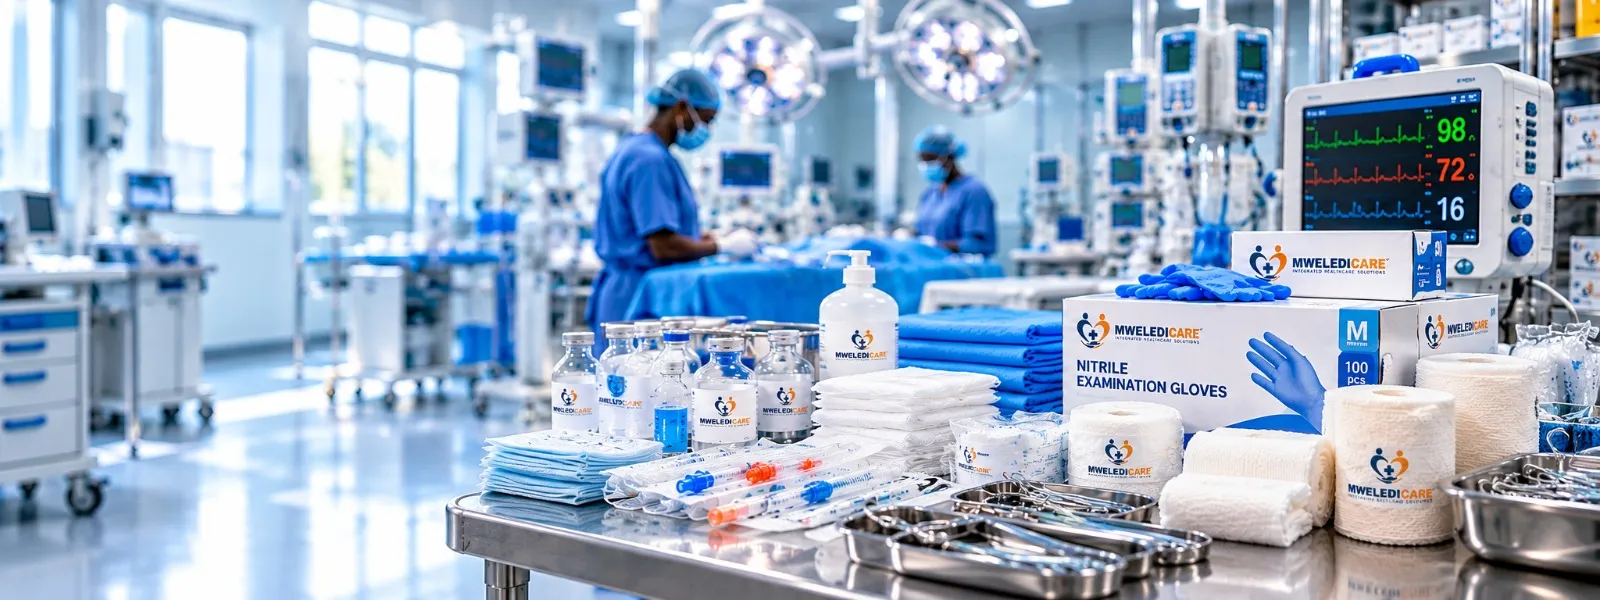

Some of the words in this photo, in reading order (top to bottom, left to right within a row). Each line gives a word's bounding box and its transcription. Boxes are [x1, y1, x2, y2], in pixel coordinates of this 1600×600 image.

[1437, 117, 1466, 143] 98
[1437, 157, 1466, 182] 72
[1437, 196, 1465, 222] 16
[1292, 257, 1386, 270] MWELEDICARE
[1114, 324, 1200, 339] MWELEDICARE
[1346, 320, 1368, 341] M
[835, 351, 888, 359] MWELEDICARE
[1076, 359, 1128, 375] NITRILE
[1345, 361, 1369, 374] 100
[1076, 375, 1167, 394] EXAMINATION
[1170, 382, 1228, 398] GLOVES
[1347, 376, 1366, 385] pcs
[699, 417, 751, 425] MWELEDICARE
[1088, 465, 1151, 476] MWELEDICARE
[1348, 483, 1433, 499] MWELEDICARE
